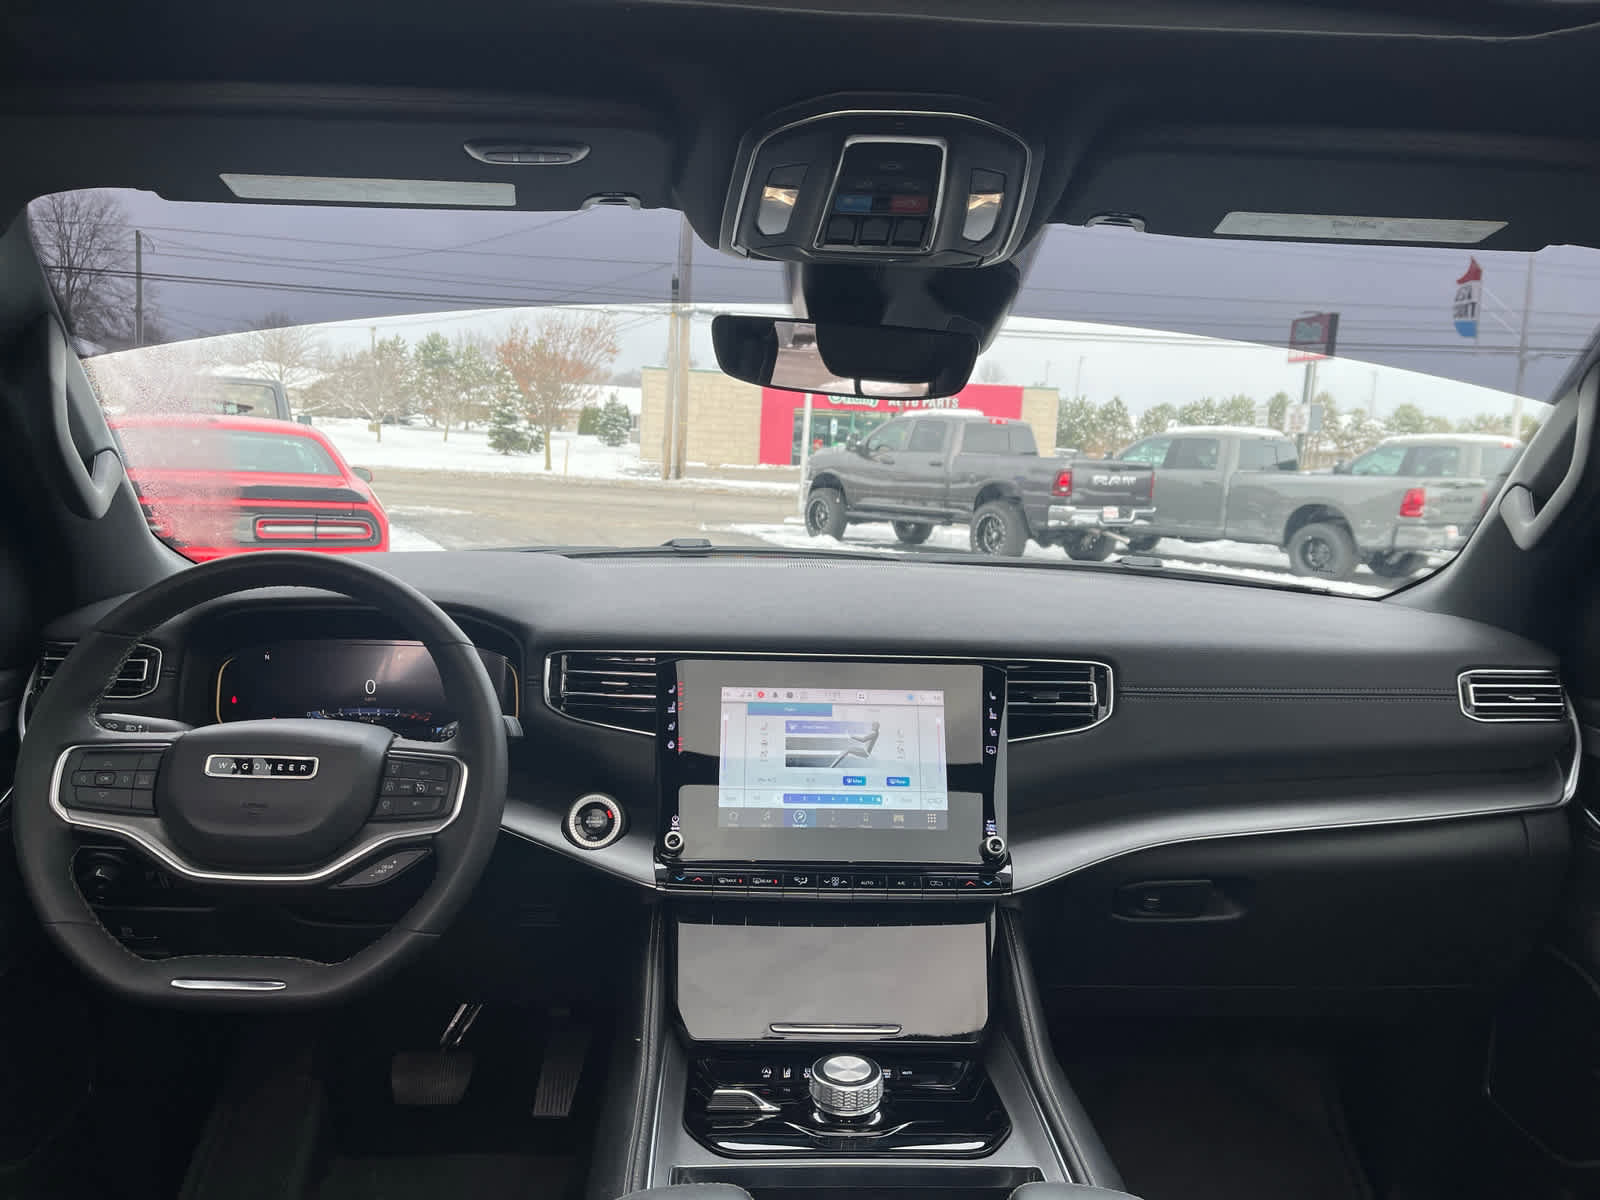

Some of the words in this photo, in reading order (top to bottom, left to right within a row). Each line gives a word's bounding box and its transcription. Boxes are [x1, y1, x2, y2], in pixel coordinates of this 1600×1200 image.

[922, 397, 960, 409] PARTS
[1092, 475, 1136, 487] RAM
[364, 678, 377, 695] 0
[218, 761, 308, 772] WAGONEER
